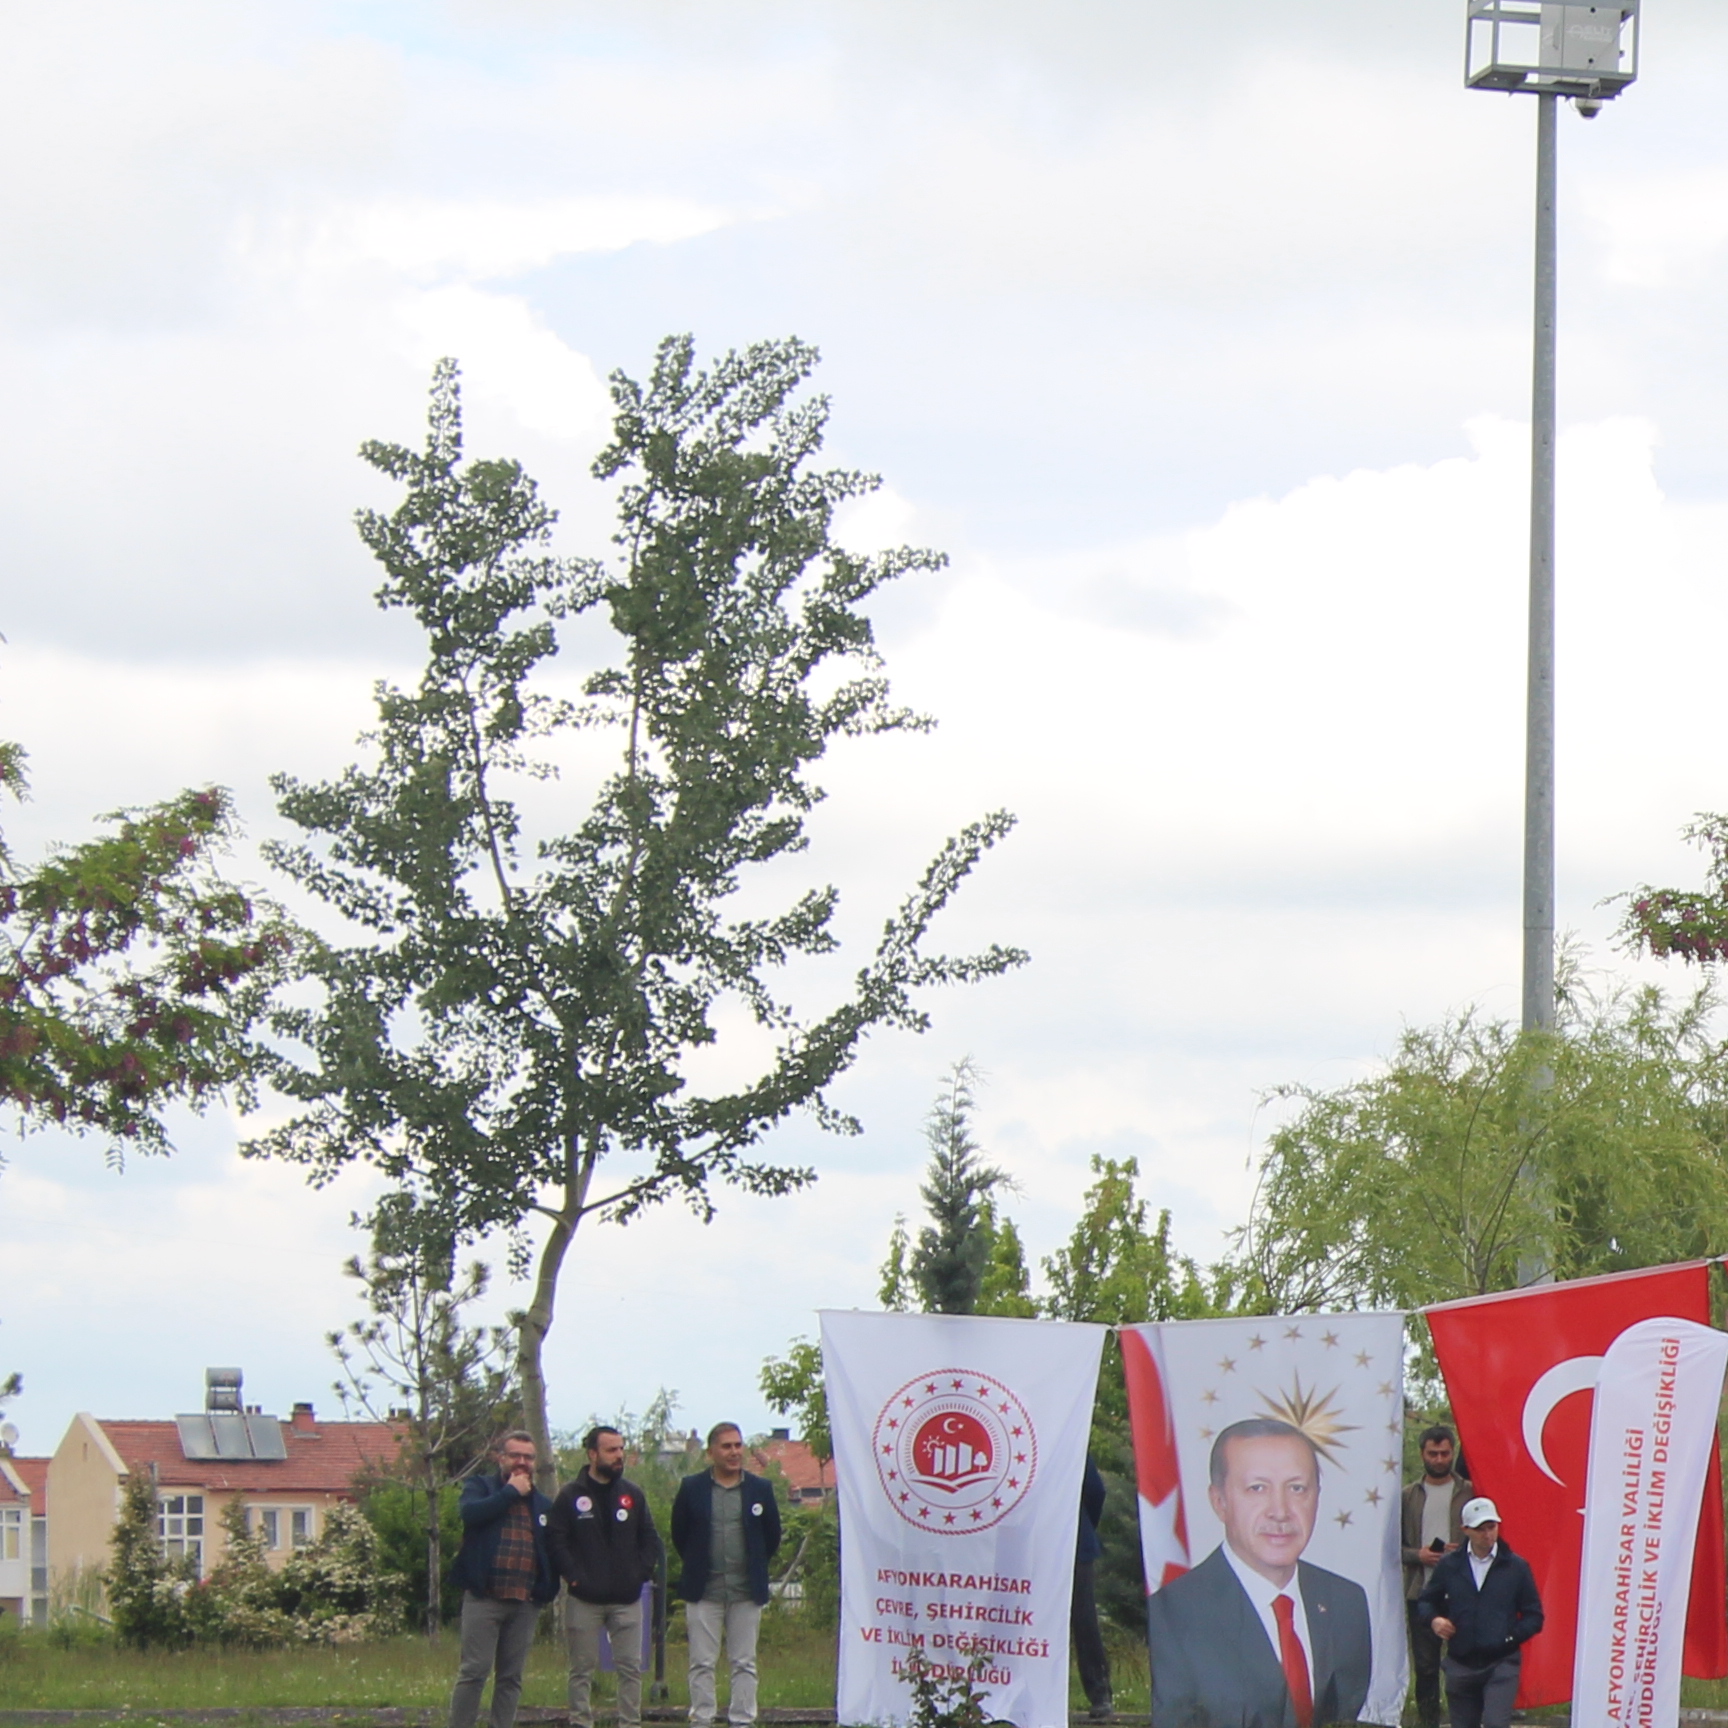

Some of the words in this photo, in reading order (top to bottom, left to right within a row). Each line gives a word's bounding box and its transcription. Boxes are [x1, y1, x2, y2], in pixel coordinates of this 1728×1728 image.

[1653, 1337, 1681, 1463] DEĞİŞİKLİĞİ
[1643, 1471, 1666, 1530] İKLİM
[1646, 1537, 1661, 1562] VE
[877, 1568, 1031, 1595] AFYONKARAHİSAR
[1607, 1524, 1635, 1721] AFYONKARAHİSAR
[1621, 1428, 1644, 1518] VALİLİĞİ
[876, 1598, 919, 1620] ÇEVRE,
[926, 1602, 1034, 1626] ŞEHİRCİLİK
[861, 1627, 882, 1643] VE
[888, 1626, 925, 1647] İKLİM
[933, 1631, 1050, 1658] DEĞİŞİKLİĞİ
